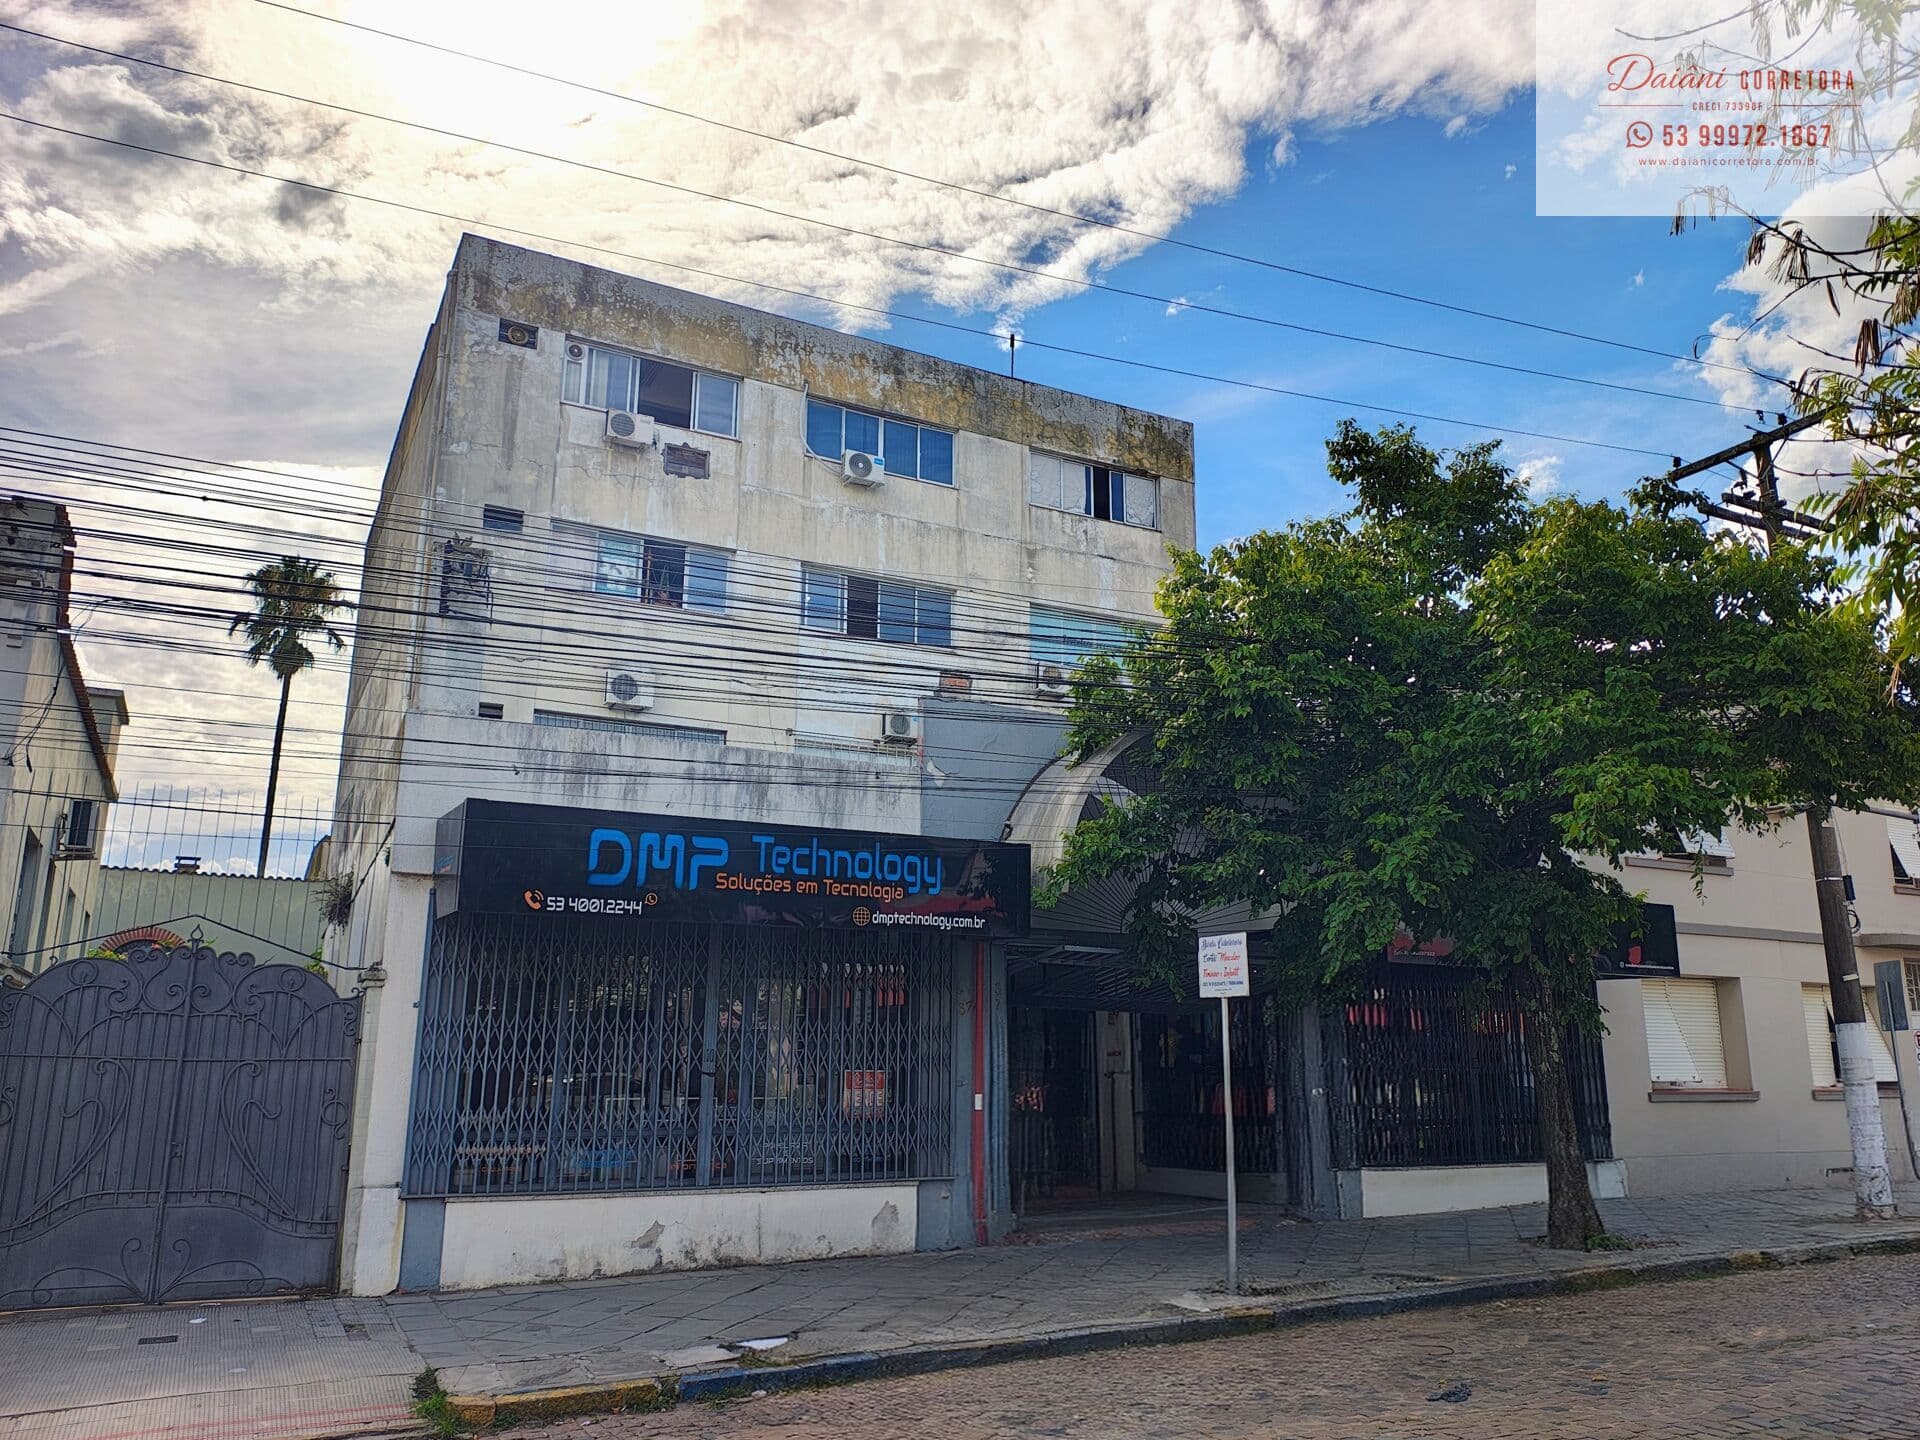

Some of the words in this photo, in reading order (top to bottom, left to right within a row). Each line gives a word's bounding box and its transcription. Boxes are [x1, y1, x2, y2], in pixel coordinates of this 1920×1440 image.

[587, 828, 729, 891] DMP
[752, 834, 943, 895] Technology
[715, 872, 791, 895] Soluções
[796, 881, 818, 895] em
[823, 879, 904, 903] Tecnologia
[546, 896, 565, 911] 53
[569, 897, 643, 915] 4001.2244
[872, 909, 986, 930] dmptechnology.com.br
